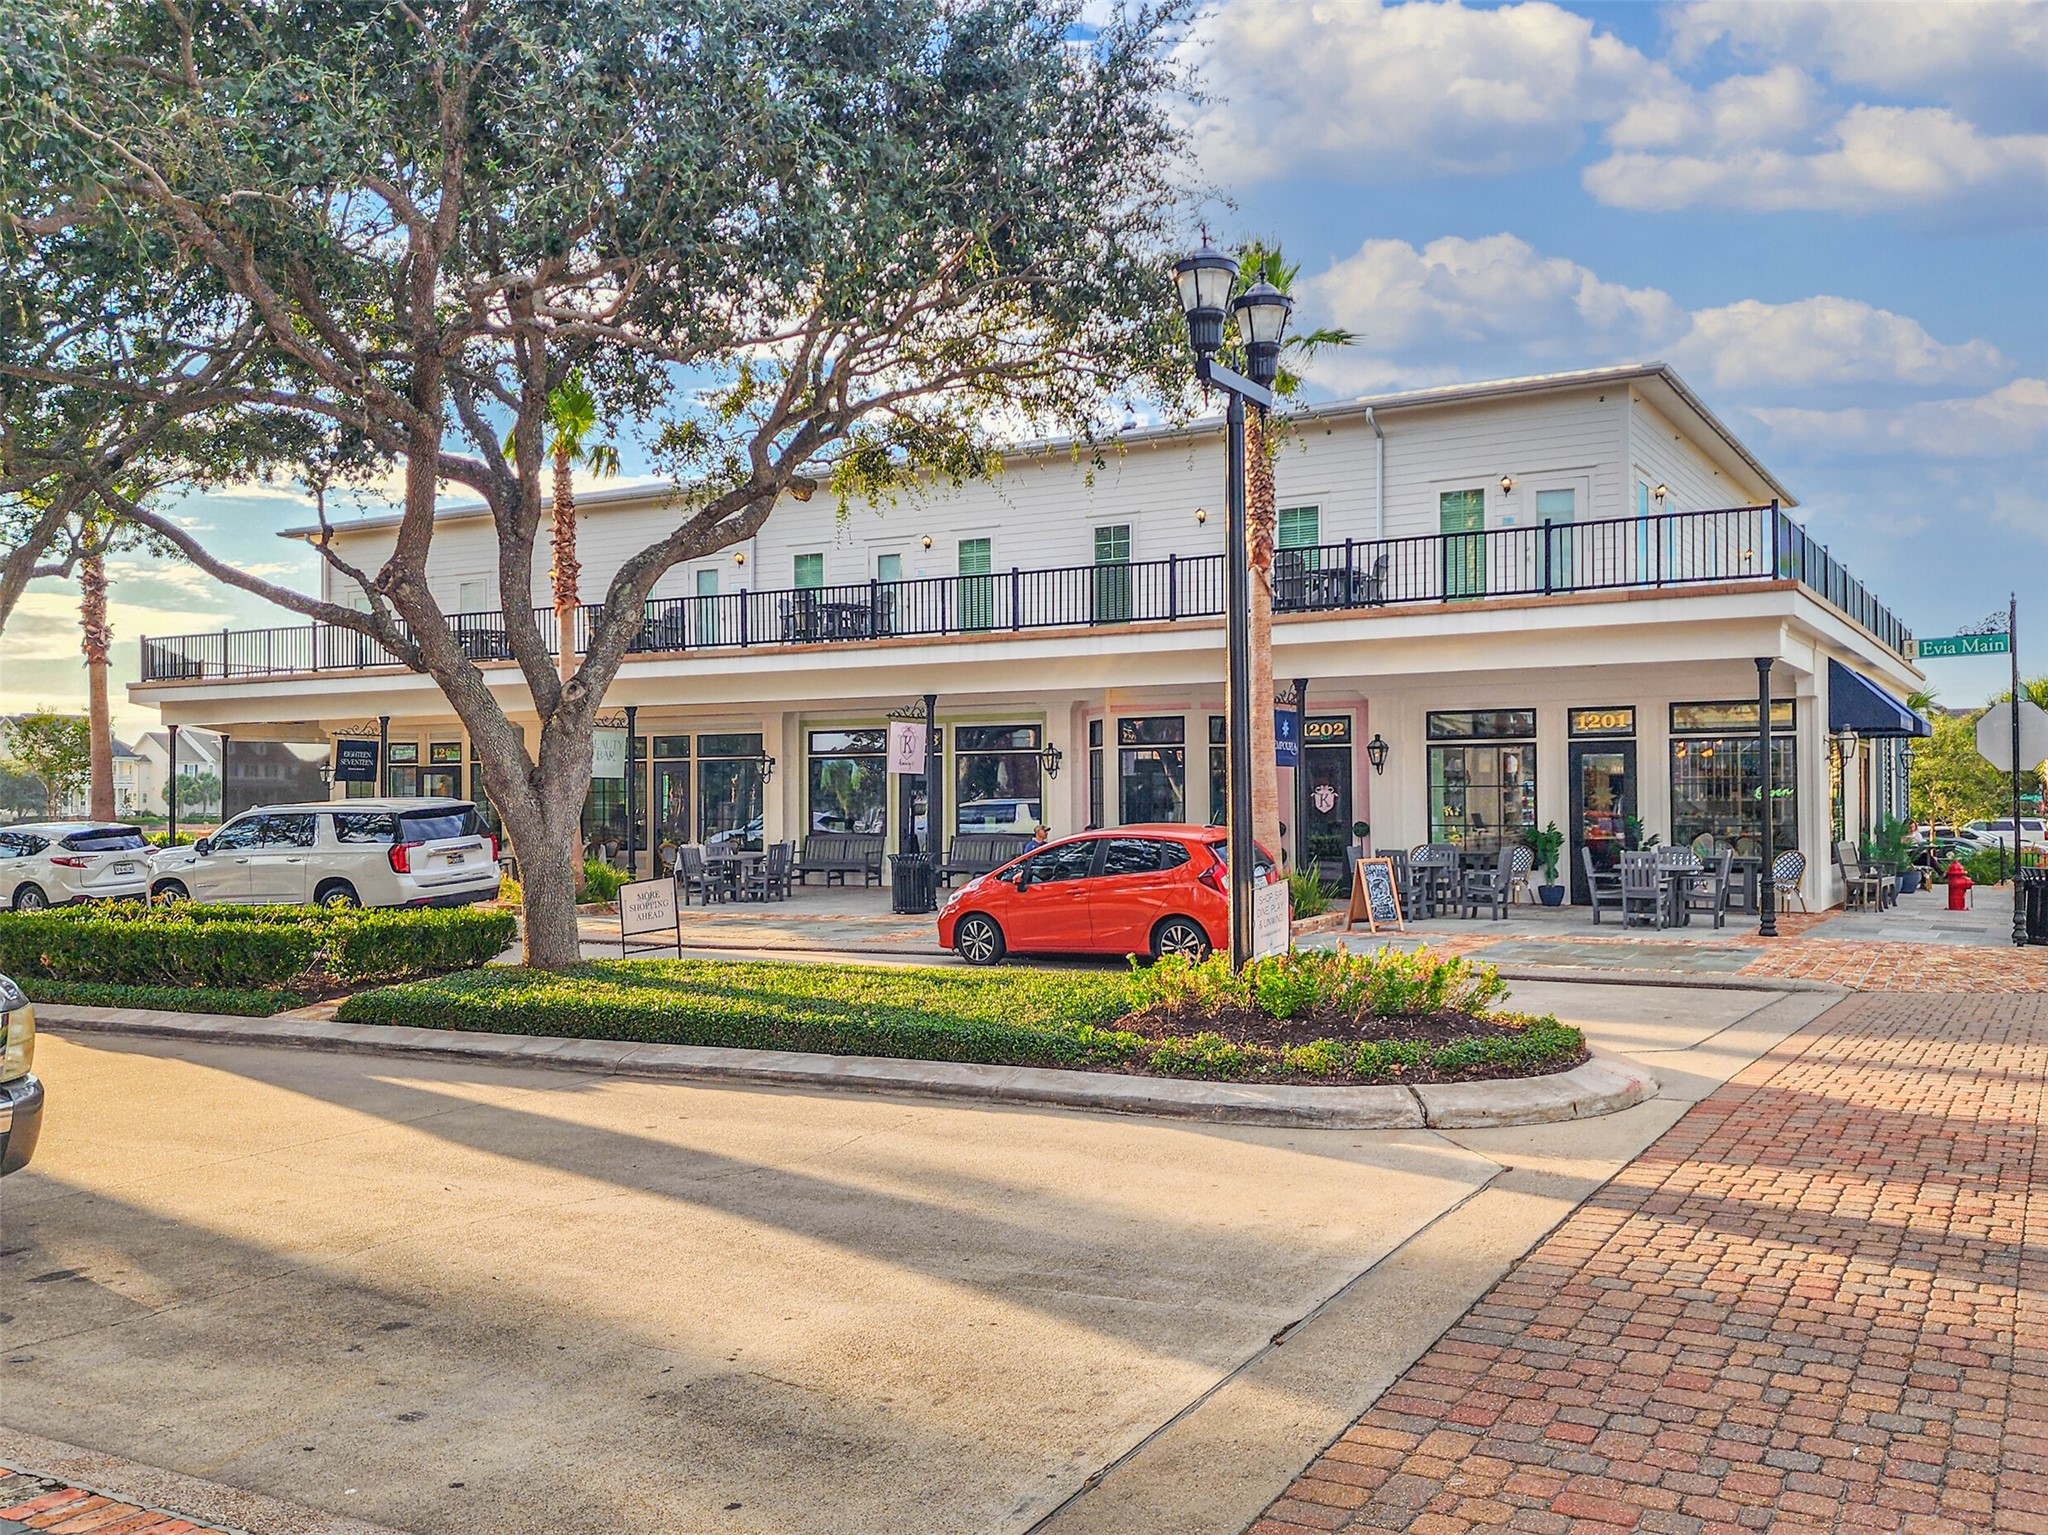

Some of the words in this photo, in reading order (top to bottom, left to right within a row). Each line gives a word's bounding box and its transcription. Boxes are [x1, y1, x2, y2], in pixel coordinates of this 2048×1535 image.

[1922, 640, 1956, 656] Evia
[1961, 637, 2005, 653] Main
[1576, 713, 1627, 729] 1201
[903, 735, 913, 754] K
[343, 750, 372, 759] EIGHTEEN
[596, 750, 616, 762] BAR
[340, 758, 374, 767] SEVENTEEN
[1319, 793, 1331, 808] K
[636, 890, 661, 902] MORE
[629, 899, 669, 913] SHOPPING
[636, 910, 665, 922] AHEAD
